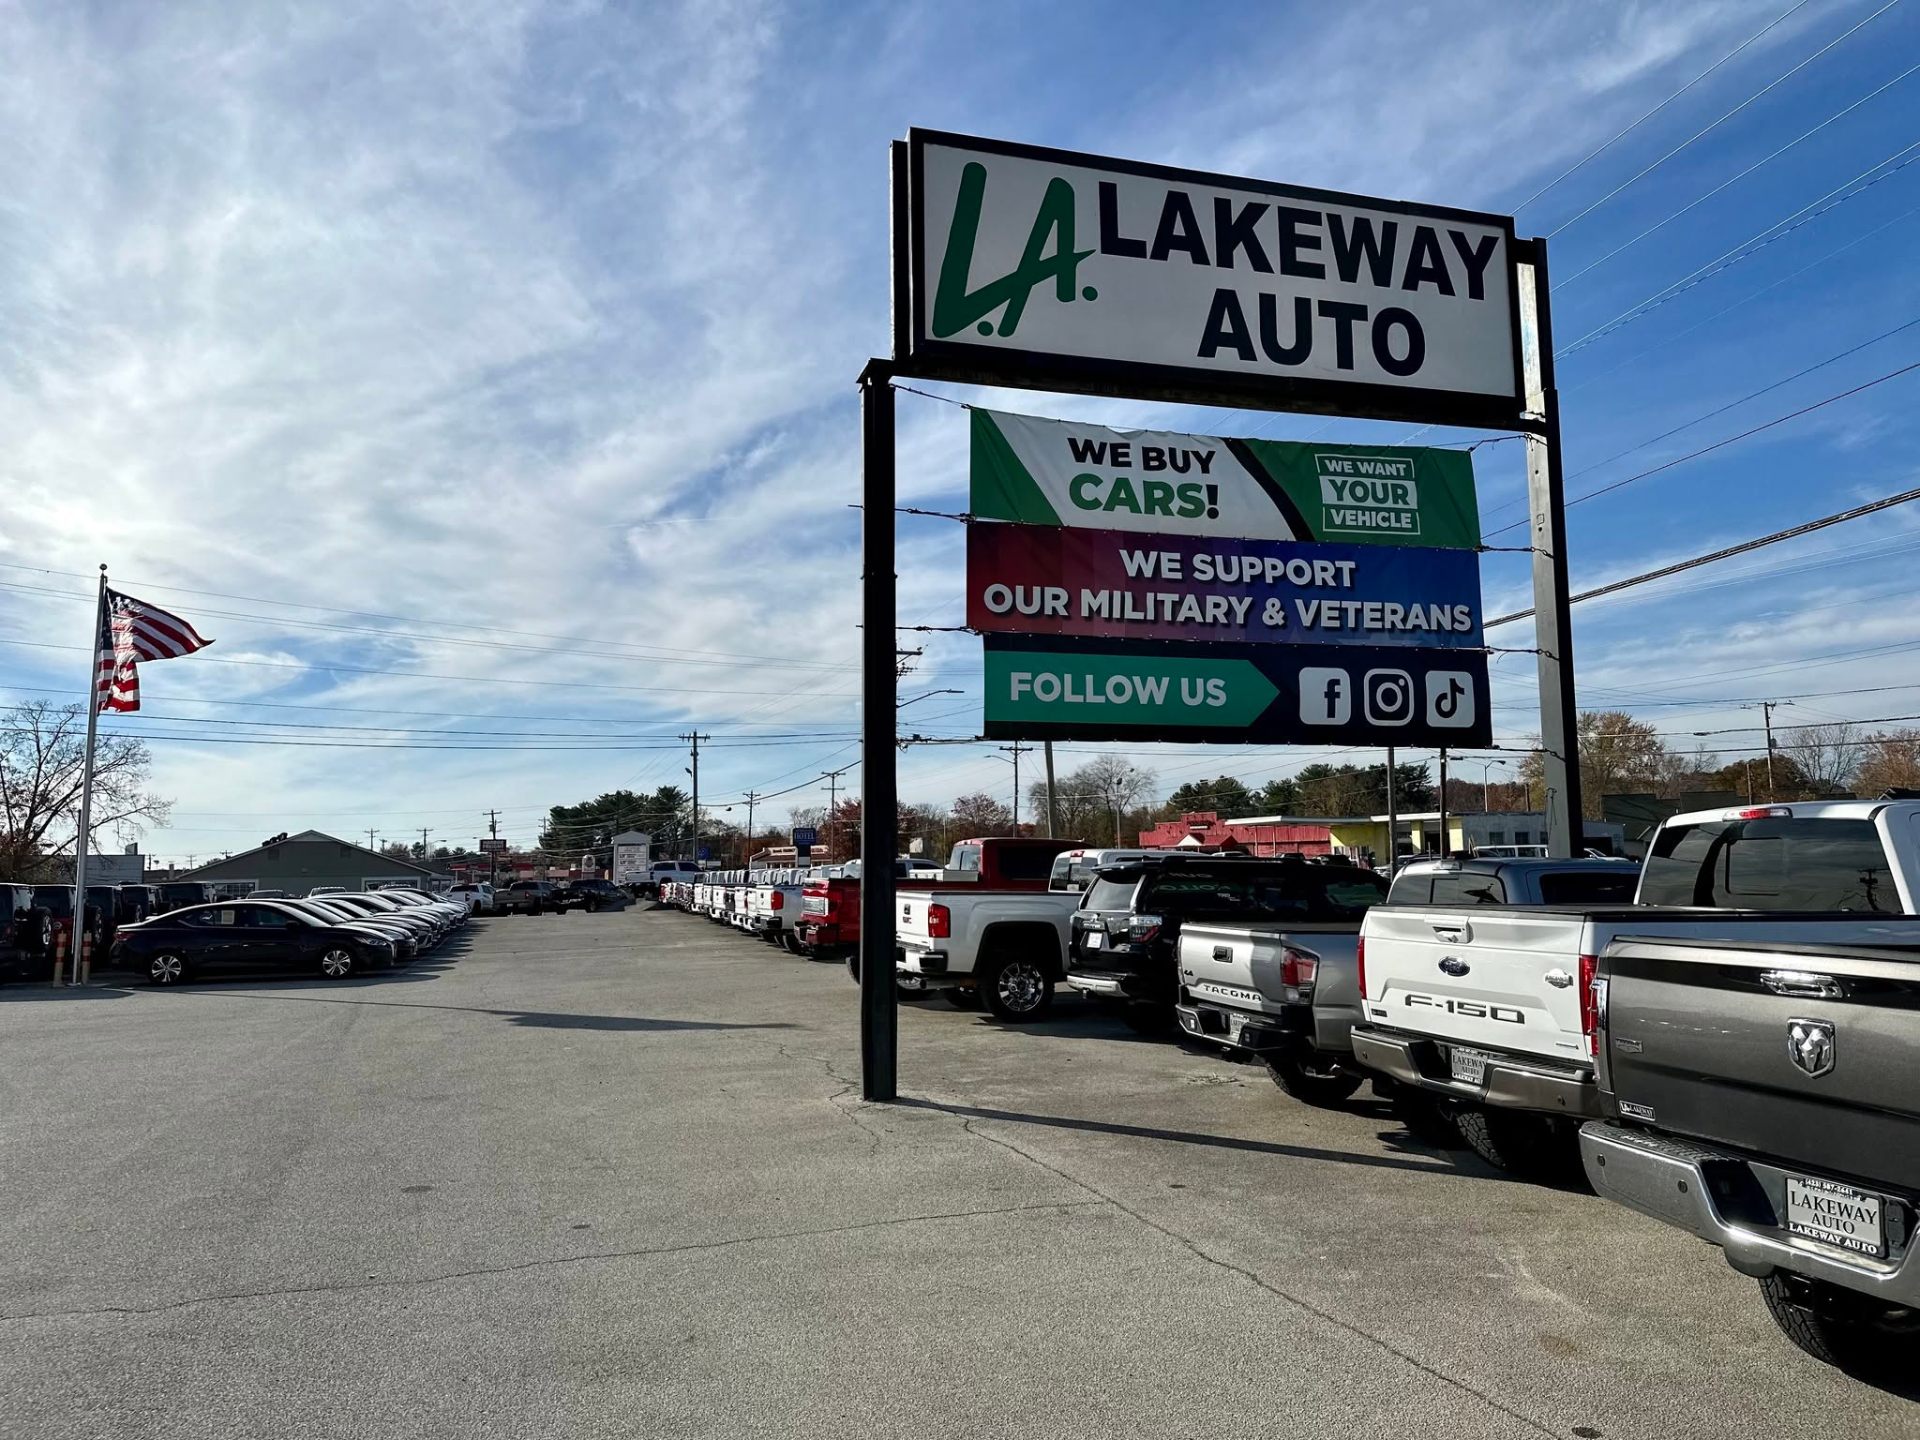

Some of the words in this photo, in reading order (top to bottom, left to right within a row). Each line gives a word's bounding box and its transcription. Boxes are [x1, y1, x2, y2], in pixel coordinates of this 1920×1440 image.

[1098, 181, 1499, 300] LAKEWAY
[1197, 287, 1426, 376] AUTO
[1066, 437, 1132, 468] WE
[1142, 445, 1216, 474] BUY
[1324, 459, 1354, 474] WE
[1357, 461, 1407, 476] WANT
[1069, 473, 1220, 520] CARS!
[1328, 479, 1410, 506] YOUR
[1331, 509, 1412, 528] VEHICLE
[1119, 549, 1183, 580] WE
[1192, 553, 1356, 588] SUPPORT
[983, 583, 1070, 617] OUR
[1081, 588, 1256, 625] MILITARY
[1262, 597, 1286, 627] &
[1295, 599, 1472, 632] VETERANS
[1010, 671, 1171, 706] FOLLOW
[1181, 677, 1227, 708] US
[1203, 984, 1262, 1001] TACOMA
[1405, 994, 1525, 1024] F-150
[1790, 1190, 1877, 1226] LAKEWAY
[1811, 1212, 1855, 1235] AUTO
[1789, 1222, 1842, 1244] LAKEWAY
[1844, 1238, 1877, 1254] AUTO
